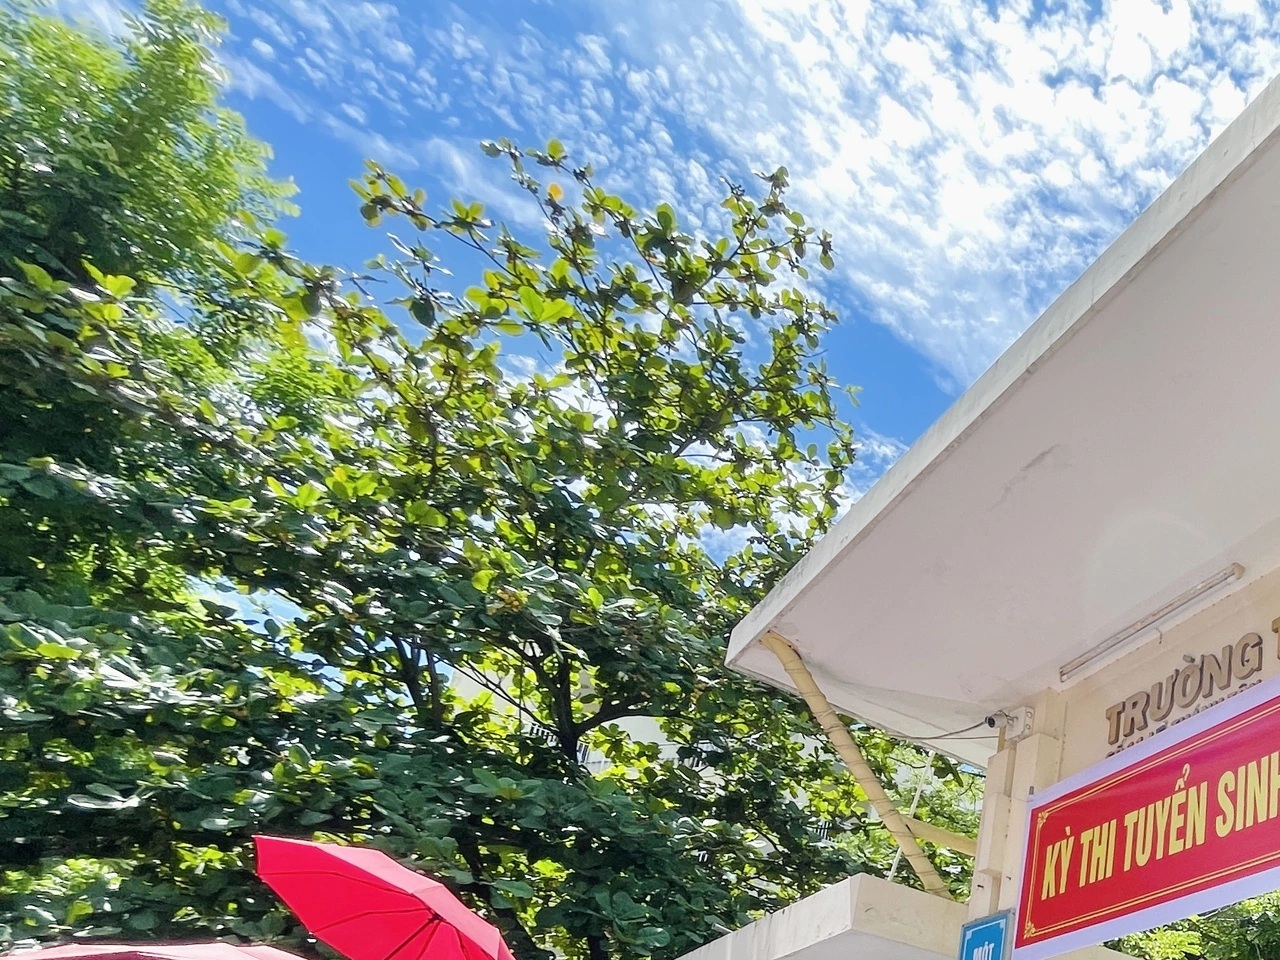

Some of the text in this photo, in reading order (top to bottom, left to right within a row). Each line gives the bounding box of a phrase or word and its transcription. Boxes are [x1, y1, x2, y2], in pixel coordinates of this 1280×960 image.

[1106, 632, 1263, 745] TRƯỜNG
[1041, 827, 1074, 901] KỲ
[1079, 819, 1117, 888] THI
[1124, 763, 1208, 872] TUYỂN
